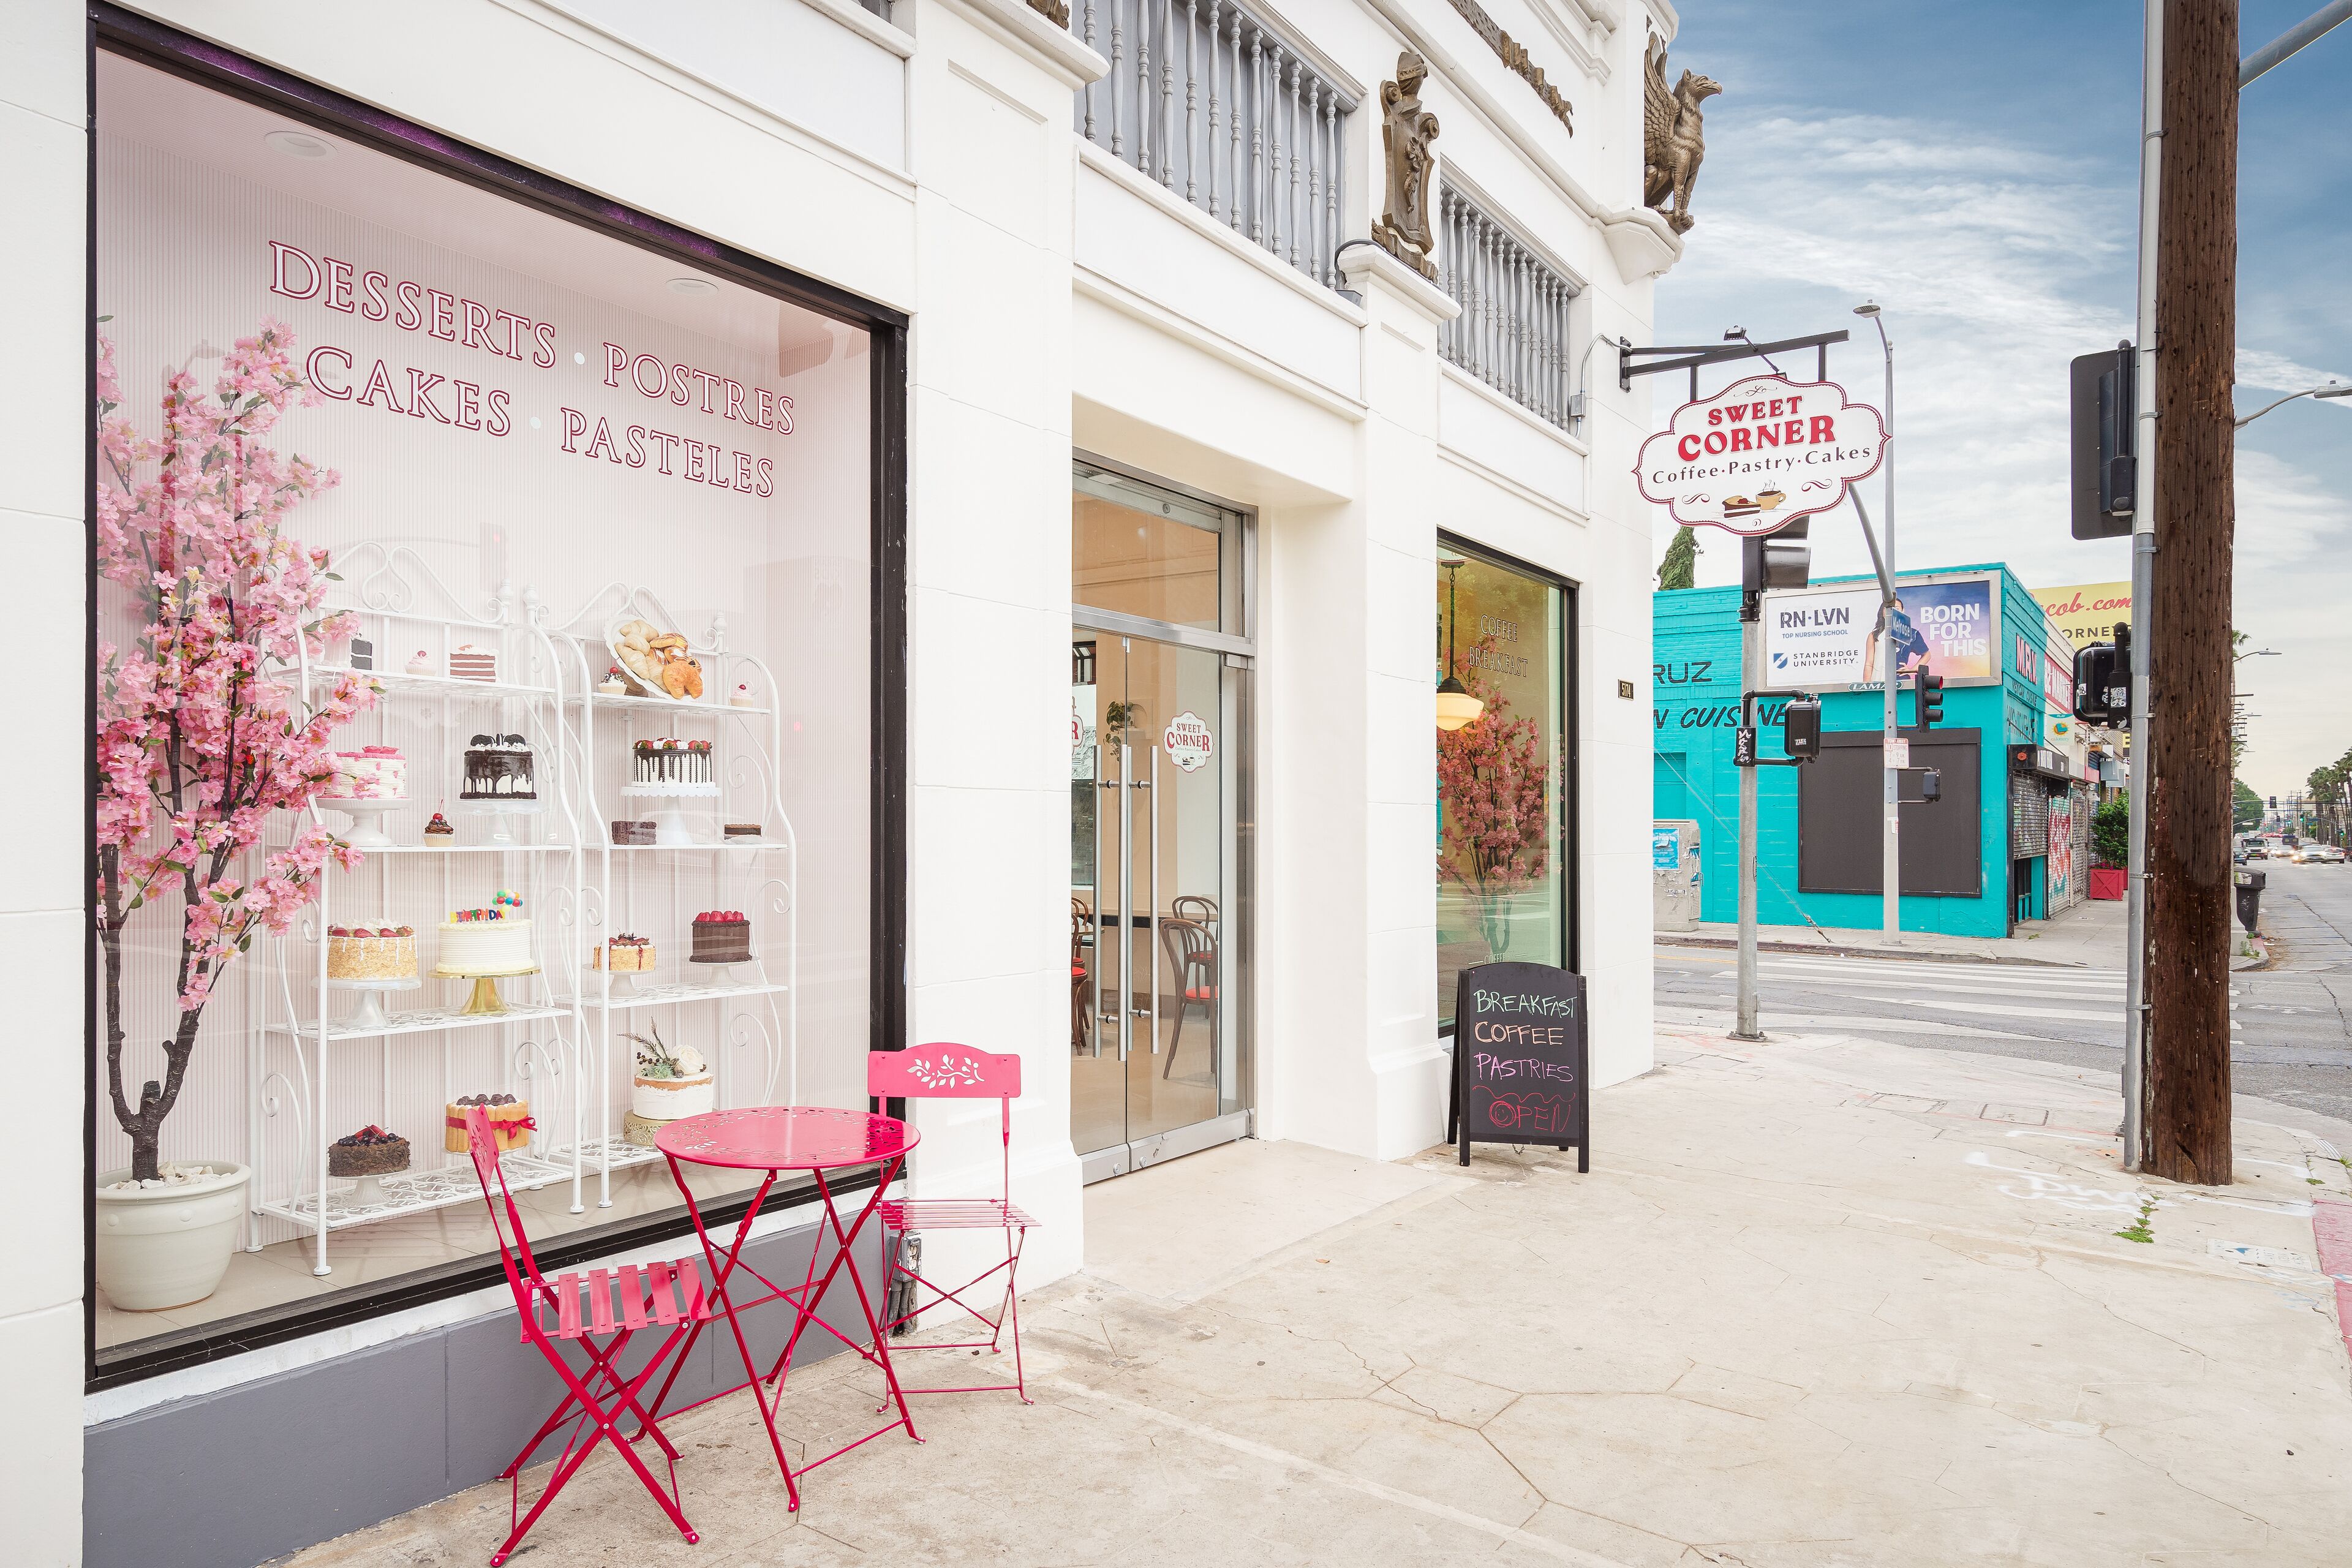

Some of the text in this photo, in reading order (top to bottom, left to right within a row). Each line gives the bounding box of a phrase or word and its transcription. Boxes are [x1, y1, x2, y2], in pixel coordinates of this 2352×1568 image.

[269, 240, 794, 435] DESSERTS POSTRES
[306, 345, 773, 497] CAKES PASTELES
[1708, 395, 1803, 427] SWEET
[1678, 415, 1836, 462] CORNER
[1653, 447, 1871, 484] Coffee Pastry Cakes
[1892, 616, 1910, 637] Melrose
[1920, 603, 1980, 624] BORN
[1480, 614, 1518, 643] COFFEE
[1929, 622, 1972, 640] FOR
[1793, 650, 1858, 659] STANBRIDGE
[1940, 638, 1987, 657] THIS
[1469, 646, 1528, 678] BREAKFAST
[1793, 658, 1855, 667] UNIVERSITY
[1621, 682, 1630, 698] 5174
[1177, 723, 1200, 733] SWEET
[1680, 703, 1786, 729] CUISNE
[1167, 732, 1210, 752] CORNER
[1473, 989, 1578, 1019] BREAKFAST
[1474, 1020, 1564, 1045] COFFEE
[1473, 1051, 1574, 1082] PASTRIES
[1488, 1100, 1572, 1133] OPEN
